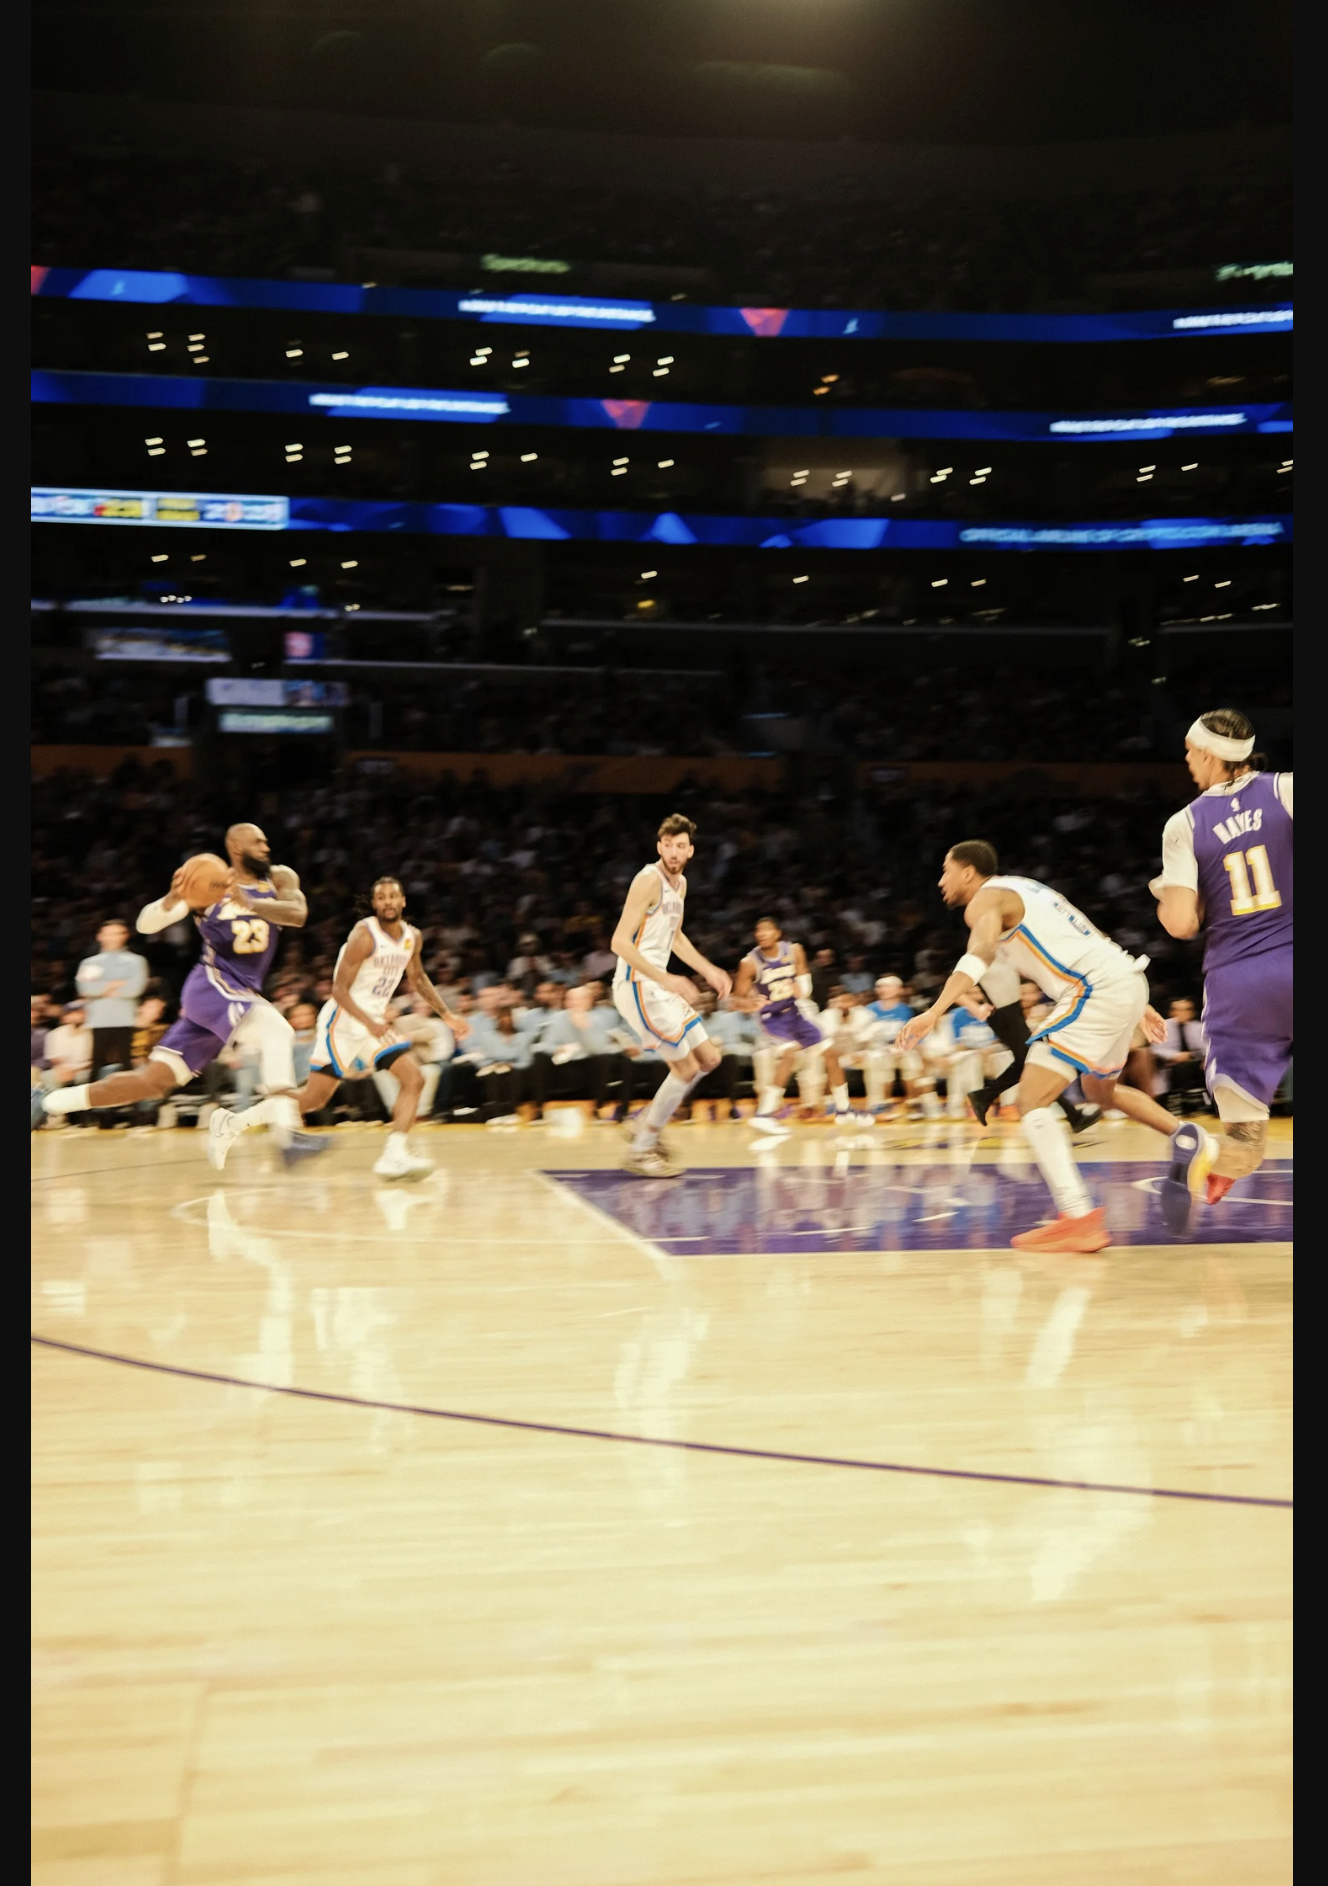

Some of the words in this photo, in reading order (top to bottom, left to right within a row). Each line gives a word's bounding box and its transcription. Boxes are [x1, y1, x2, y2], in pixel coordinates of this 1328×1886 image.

[1212, 808, 1263, 844] HAYES
[1223, 844, 1282, 916] 11
[231, 919, 270, 954] 23
[372, 977, 396, 997] 22
